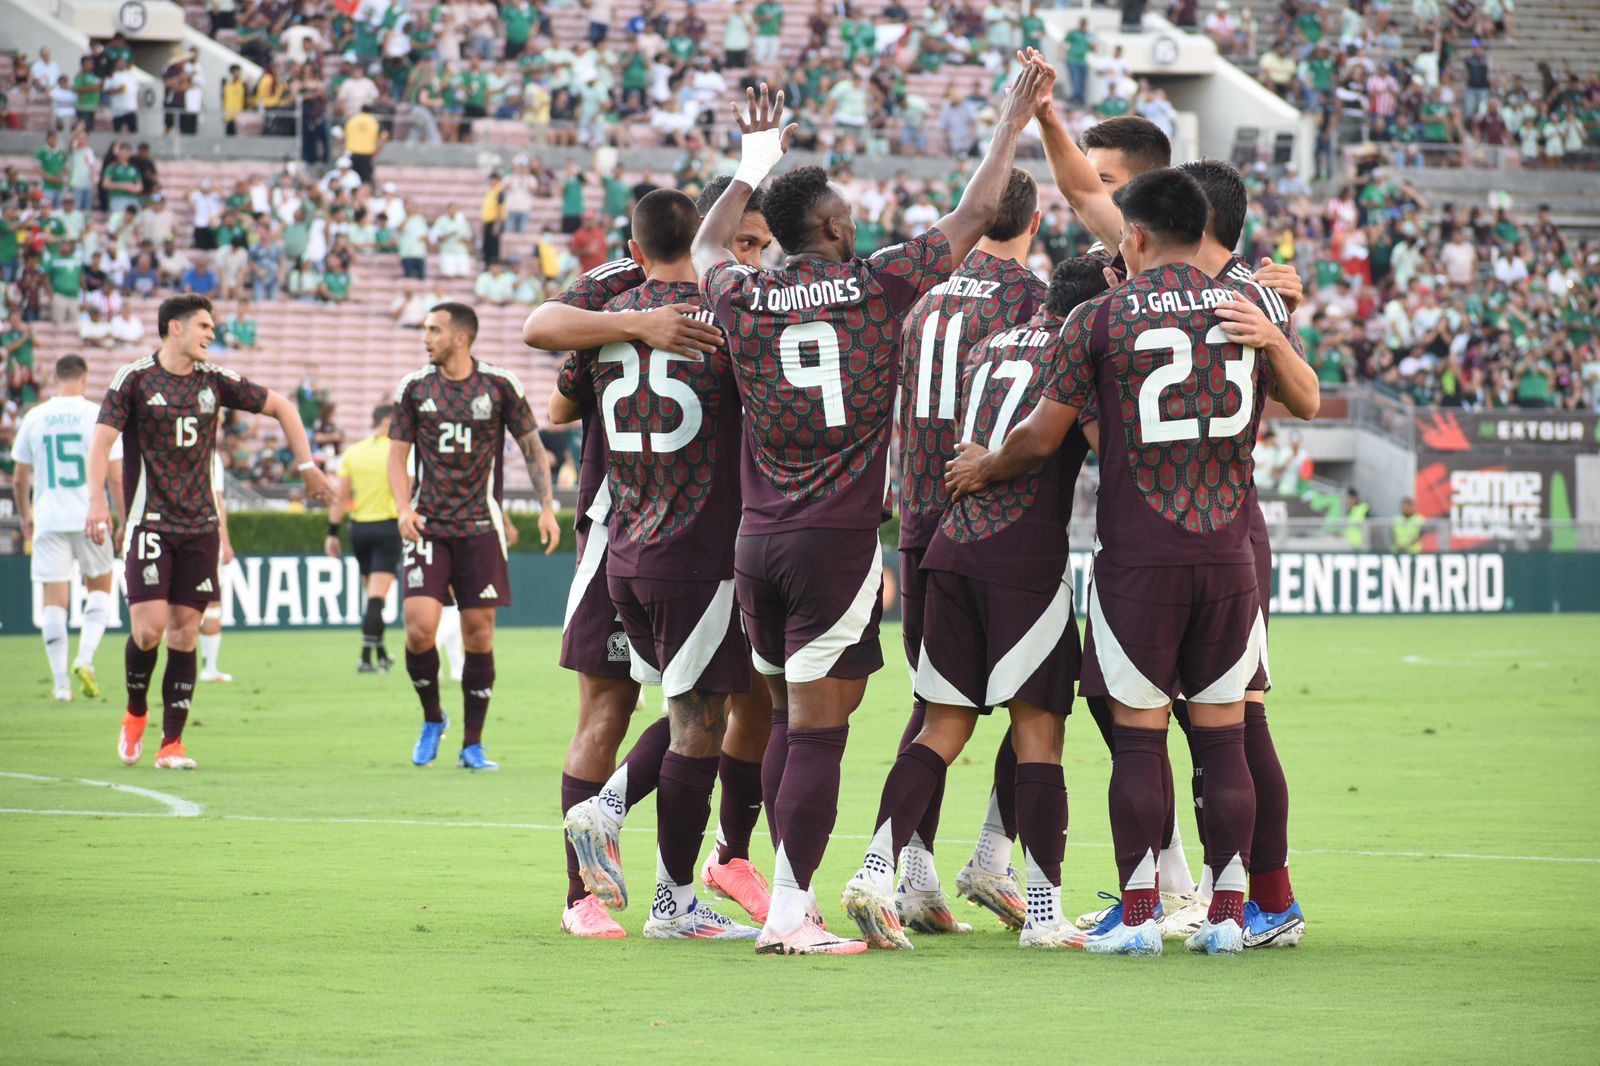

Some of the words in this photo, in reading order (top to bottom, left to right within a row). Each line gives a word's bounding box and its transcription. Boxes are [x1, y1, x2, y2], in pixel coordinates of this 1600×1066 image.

[751, 288, 763, 310] J.
[767, 277, 861, 310] QUINONES
[1127, 294, 1147, 315] J.
[1147, 288, 1234, 313] GALLAR
[780, 321, 846, 427] 9
[916, 310, 964, 419] 11
[1134, 327, 1256, 443] 23
[598, 341, 703, 453] 25
[961, 360, 1032, 449] 17
[176, 416, 198, 447] 15
[438, 422, 472, 453] 24
[43, 434, 86, 489] 15
[138, 531, 161, 560] 15
[402, 536, 433, 567] 24
